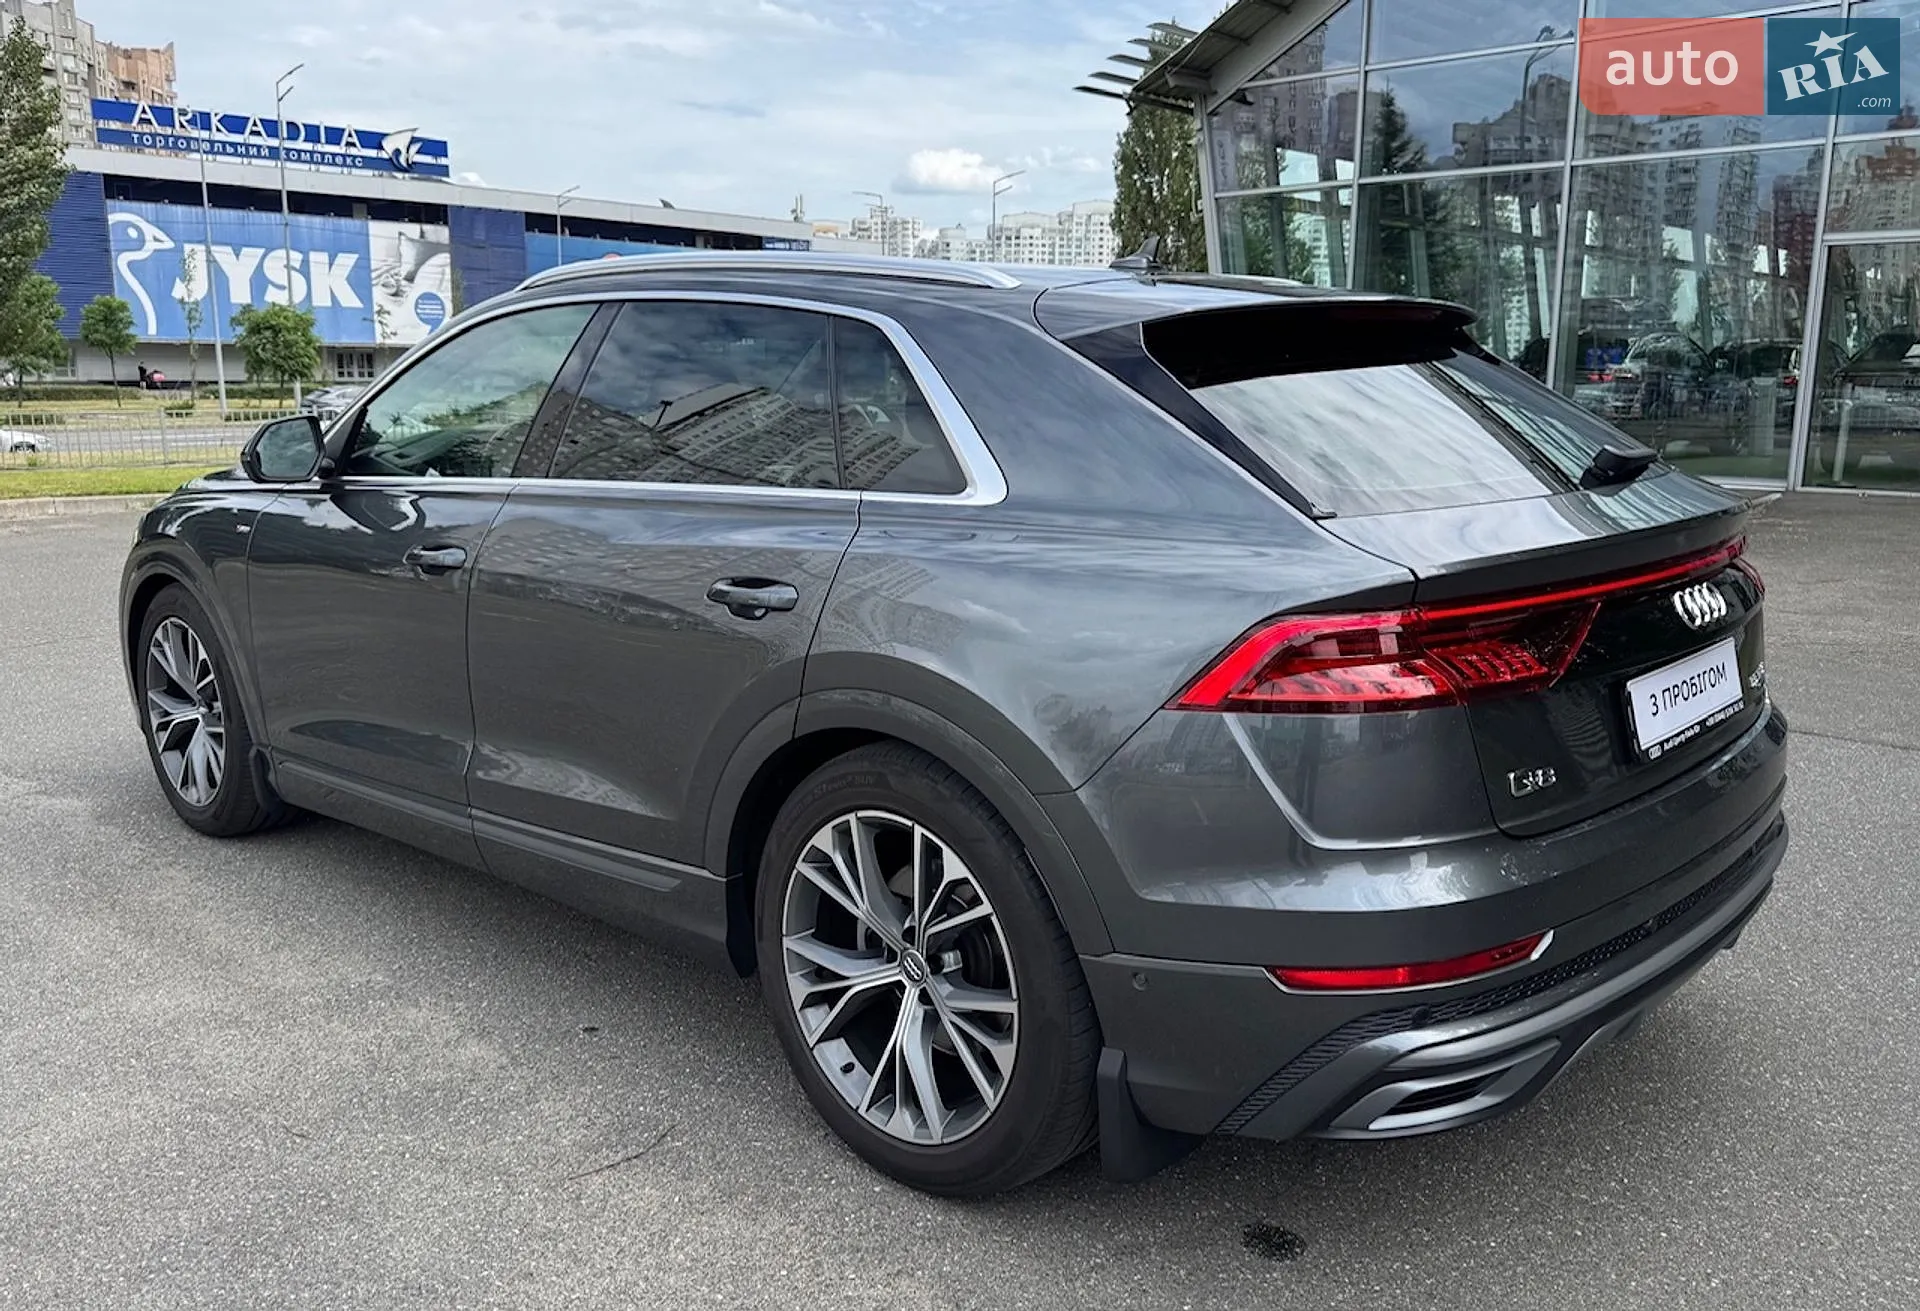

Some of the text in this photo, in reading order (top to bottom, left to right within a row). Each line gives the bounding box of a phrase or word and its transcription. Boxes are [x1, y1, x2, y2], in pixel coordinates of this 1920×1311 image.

[131, 101, 363, 151] ARKADIA
[131, 133, 271, 158] торговельний
[171, 242, 364, 309] JYSK
[1661, 661, 1728, 712] ПРОБІГОМ
